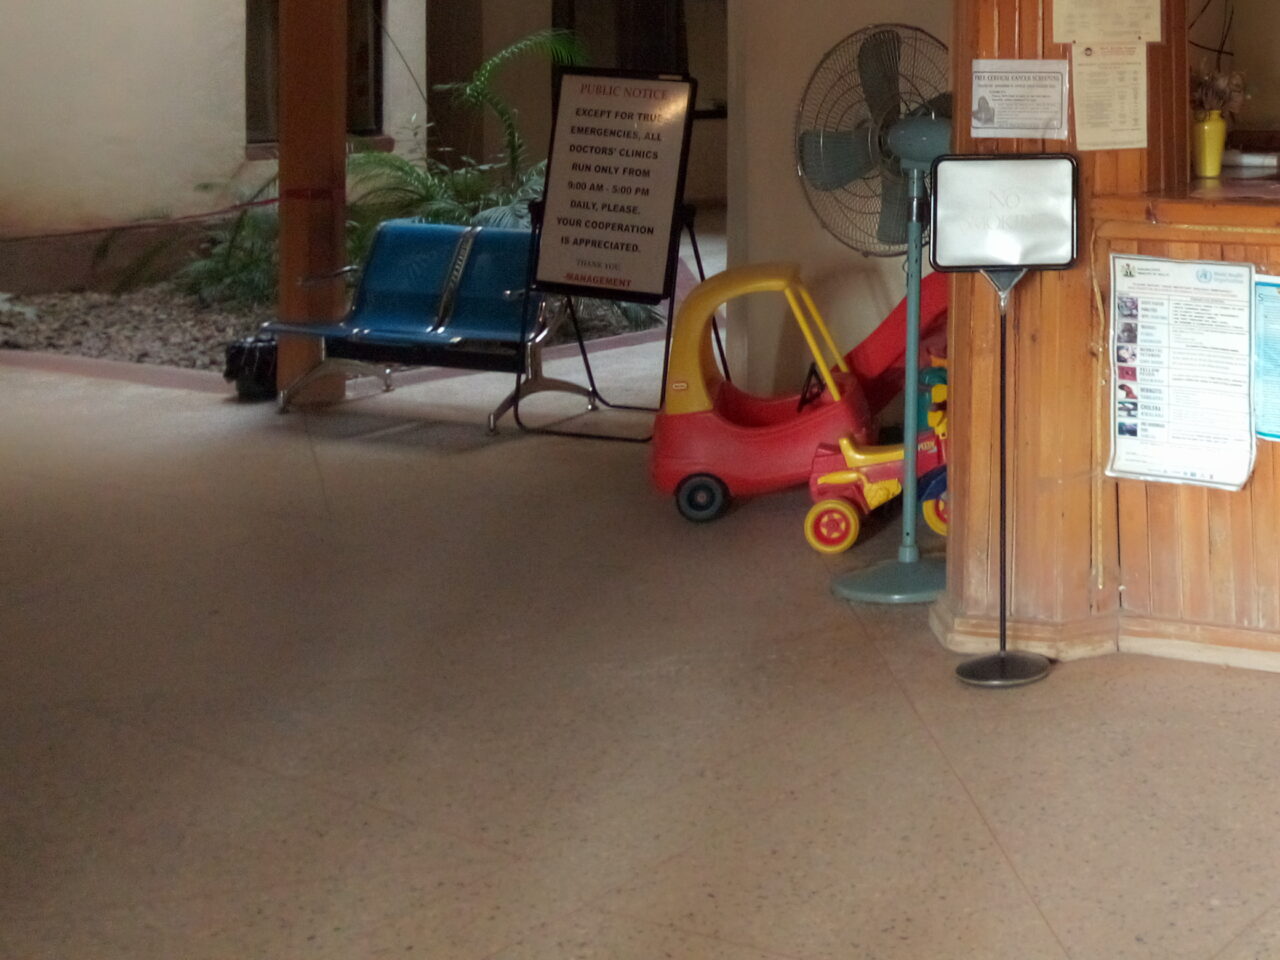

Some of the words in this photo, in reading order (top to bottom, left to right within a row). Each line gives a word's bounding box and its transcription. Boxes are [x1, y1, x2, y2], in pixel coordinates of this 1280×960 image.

[580, 83, 621, 98] PUBLIC
[623, 87, 667, 100] NOTICE
[575, 107, 612, 120] EXCEPT
[614, 110, 634, 121] FOR
[570, 125, 641, 141] EMERGENCIES,
[644, 132, 662, 141] ALL
[619, 148, 659, 160] CLINICS
[571, 163, 592, 173] RUN
[594, 165, 620, 176] ONLY
[622, 167, 651, 178] FROM
[567, 181, 587, 192] 9:00
[589, 182, 604, 192] AM
[611, 185, 632, 195] 5:00
[634, 187, 650, 197] PM
[570, 199, 599, 212] DAILY,
[601, 202, 641, 215] PLEASE.
[987, 190, 1021, 209] NO
[556, 216, 582, 228] YOUR
[585, 219, 655, 235] COOPERATION
[561, 236, 570, 245] IS
[572, 237, 641, 253] APPRECIATED.
